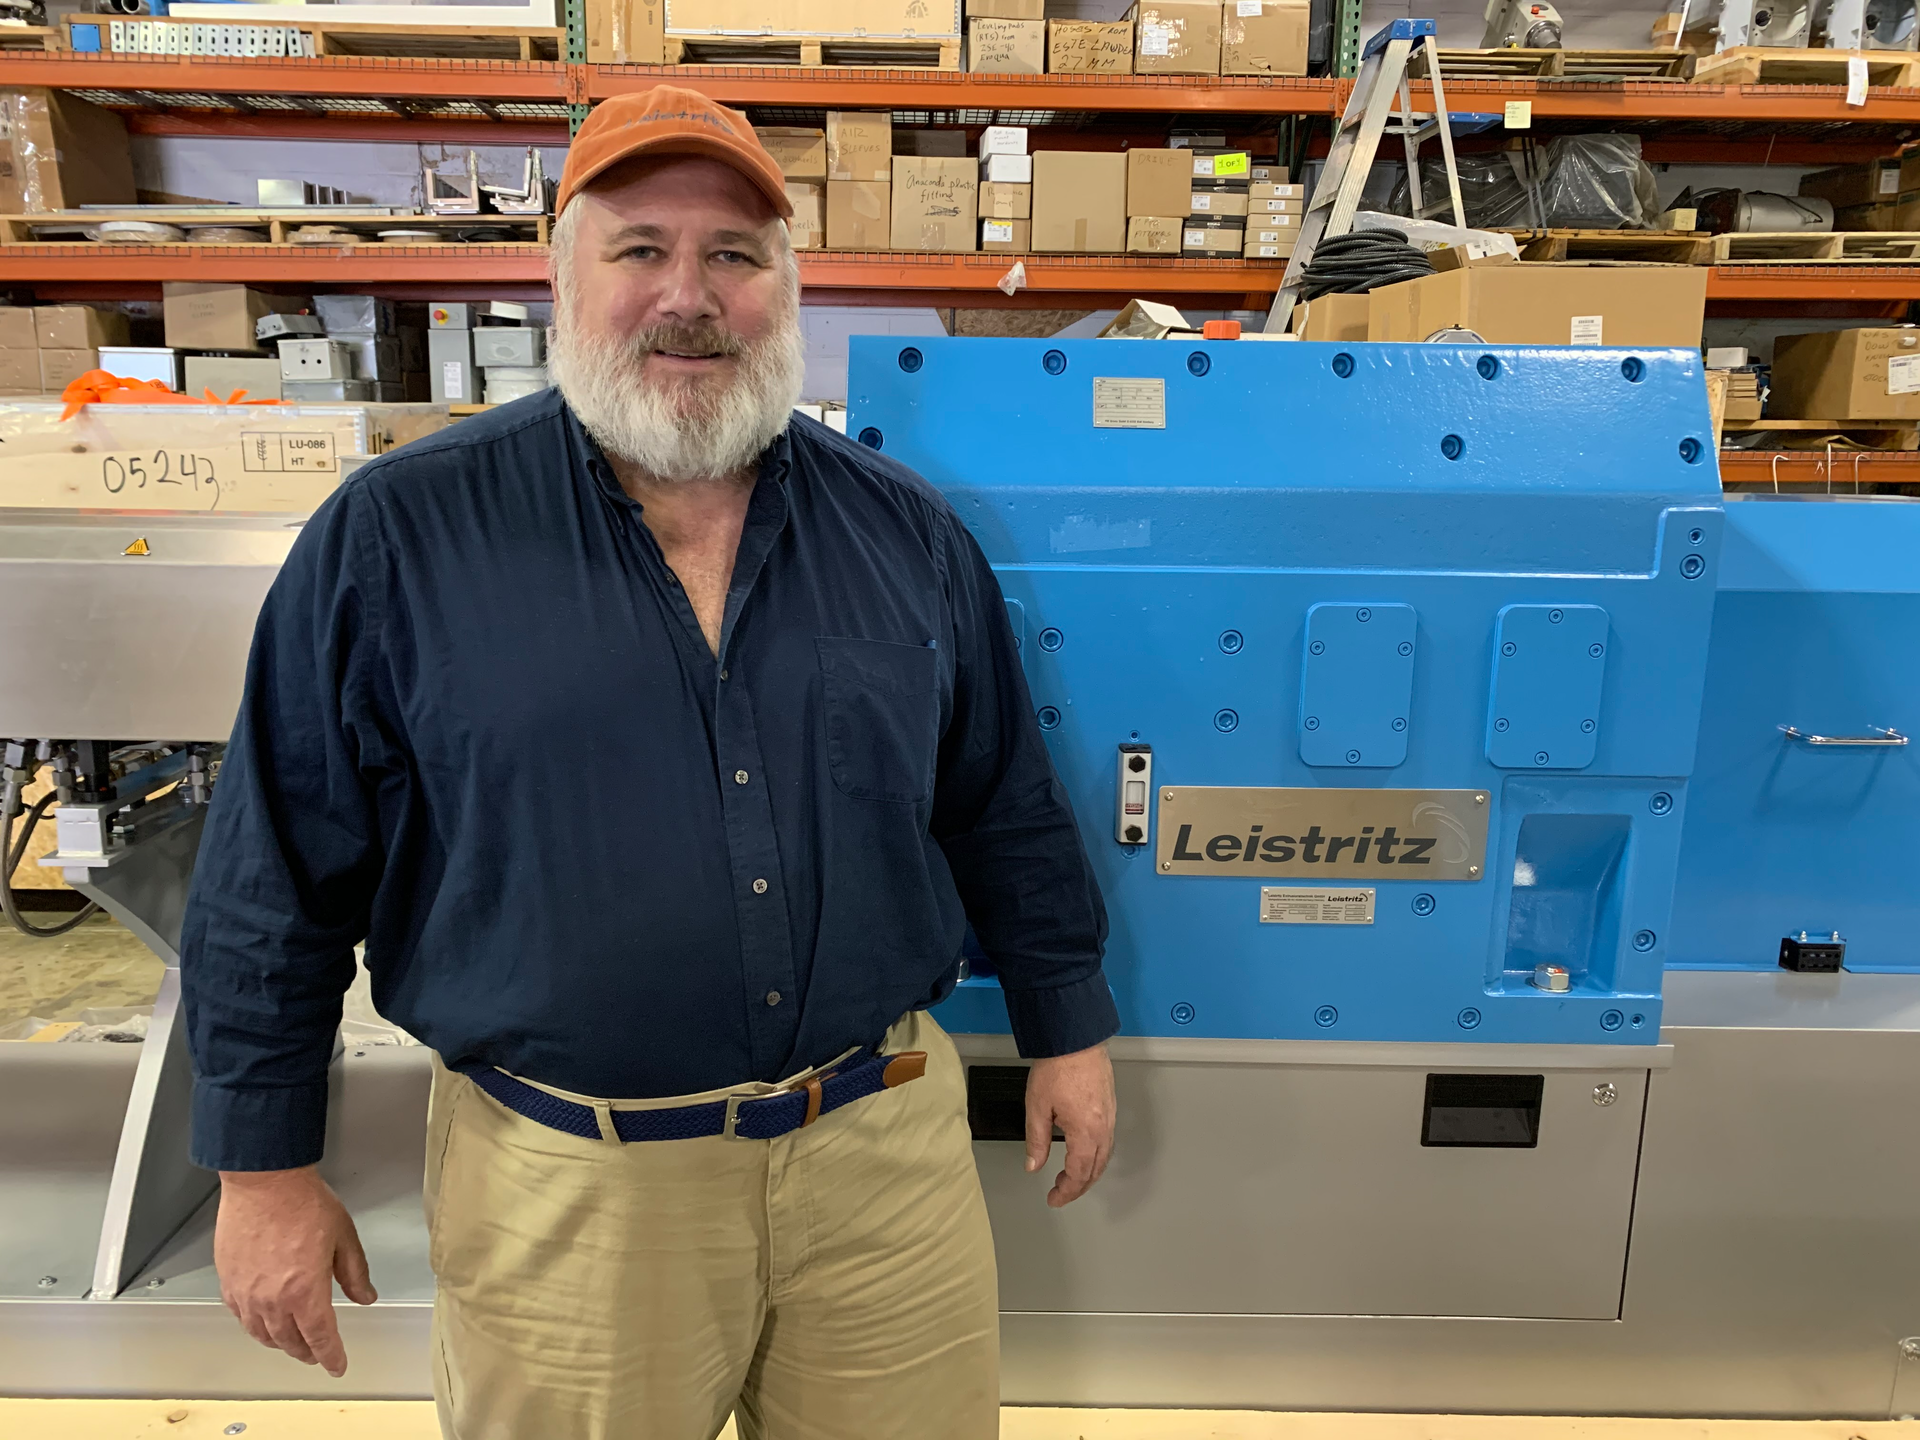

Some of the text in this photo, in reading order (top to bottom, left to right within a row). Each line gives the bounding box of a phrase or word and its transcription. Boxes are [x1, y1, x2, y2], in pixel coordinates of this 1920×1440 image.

[1098, 26, 1128, 35] FROM
[1058, 54, 1082, 71] 27
[840, 127, 869, 139] AIR
[840, 143, 881, 156] SLEEVES
[1225, 160, 1236, 168] OF
[288, 439, 326, 449] LU-086
[291, 457, 305, 466] HT
[1172, 824, 1437, 864] Leistritz
